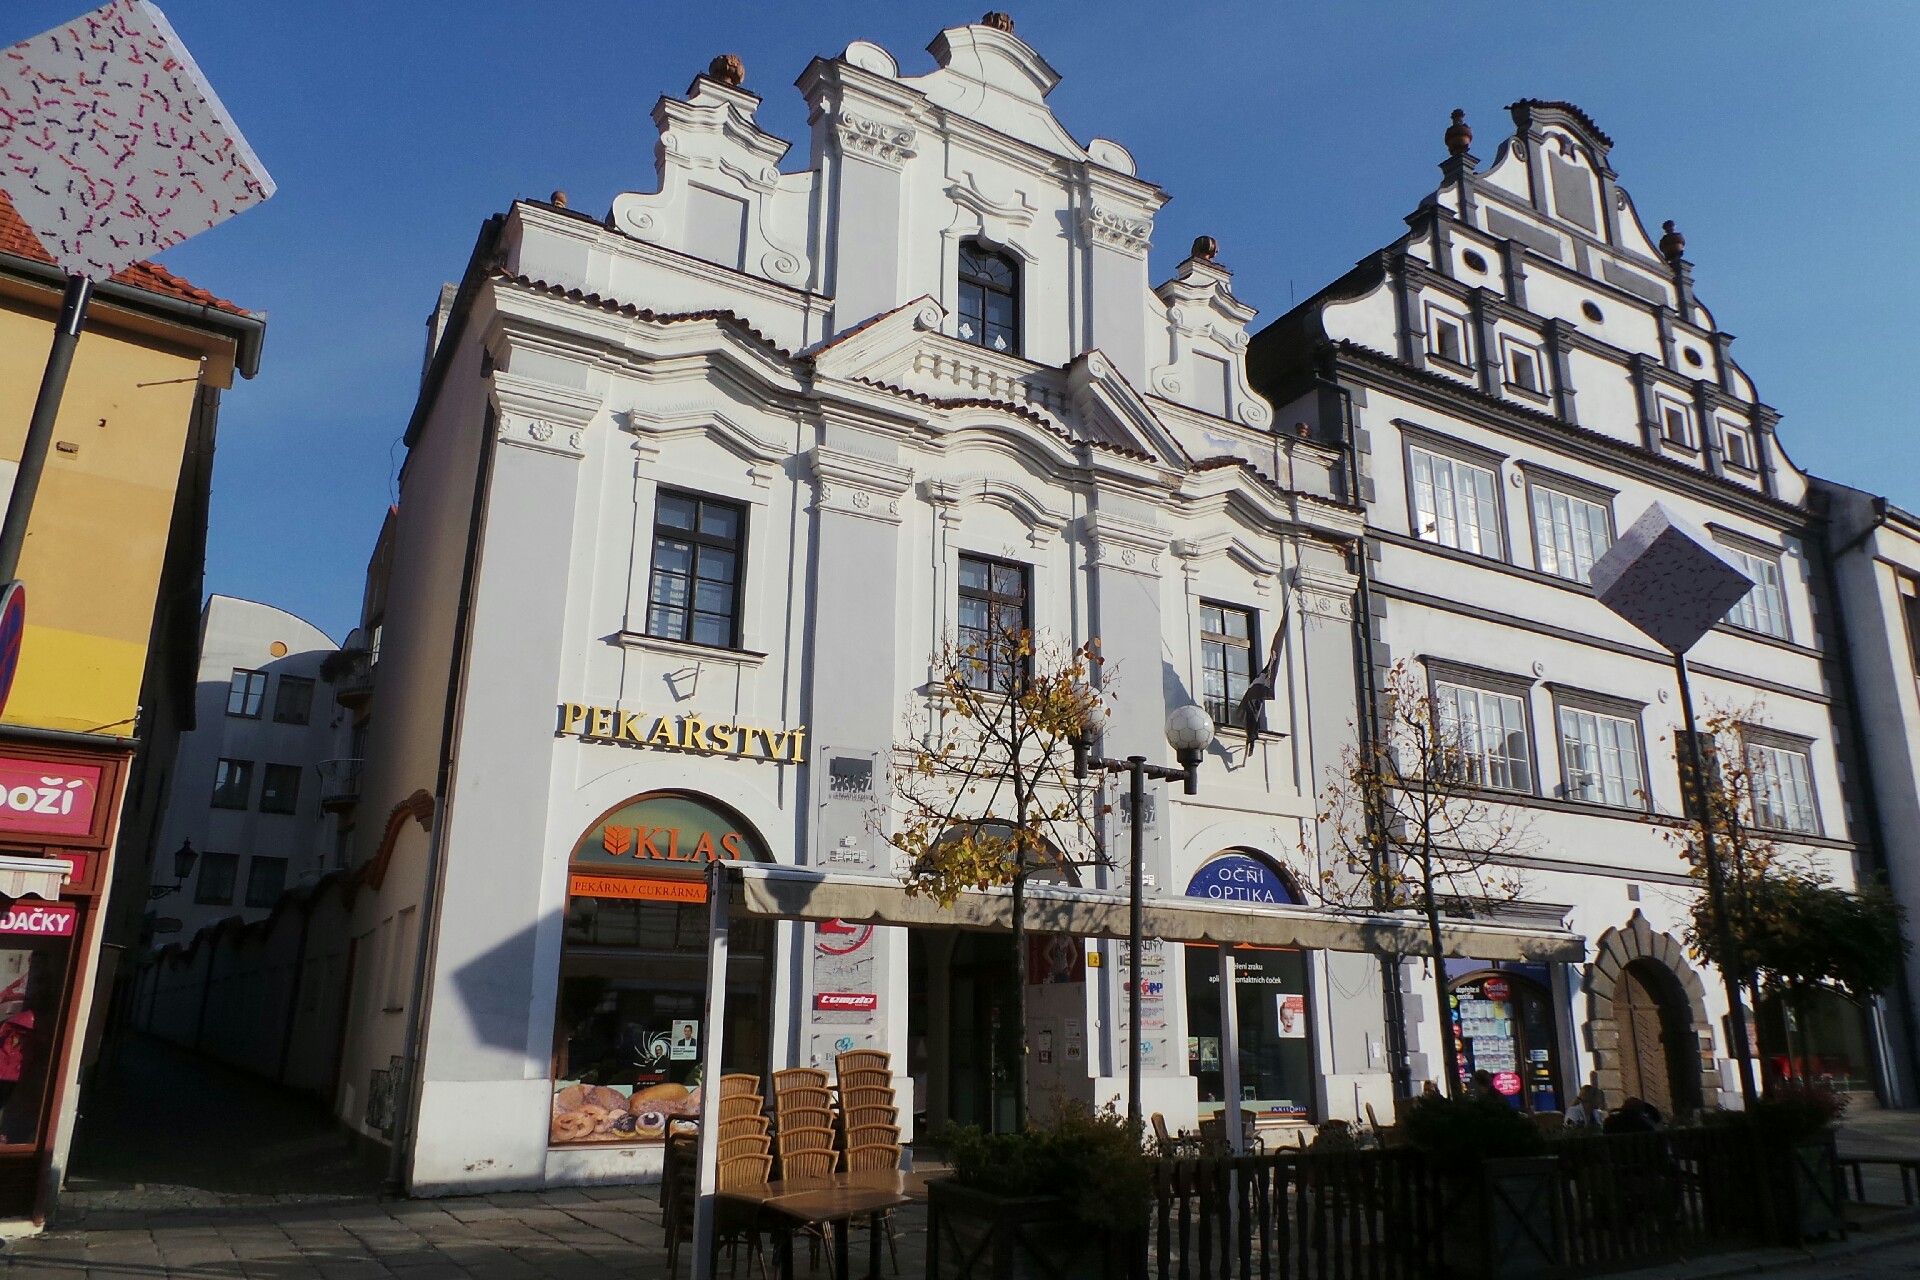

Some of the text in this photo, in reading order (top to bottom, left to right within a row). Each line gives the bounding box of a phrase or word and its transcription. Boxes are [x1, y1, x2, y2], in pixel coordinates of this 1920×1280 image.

[561, 702, 806, 763] PEKAŘSTVÍ
[0, 776, 83, 815] oží
[633, 826, 743, 863] KLAS
[574, 879, 628, 894] PEKÁRNA
[638, 884, 700, 898] CUKRÁRNA
[1218, 866, 1264, 884] OČNÍ
[1208, 885, 1275, 903] OPTIKA
